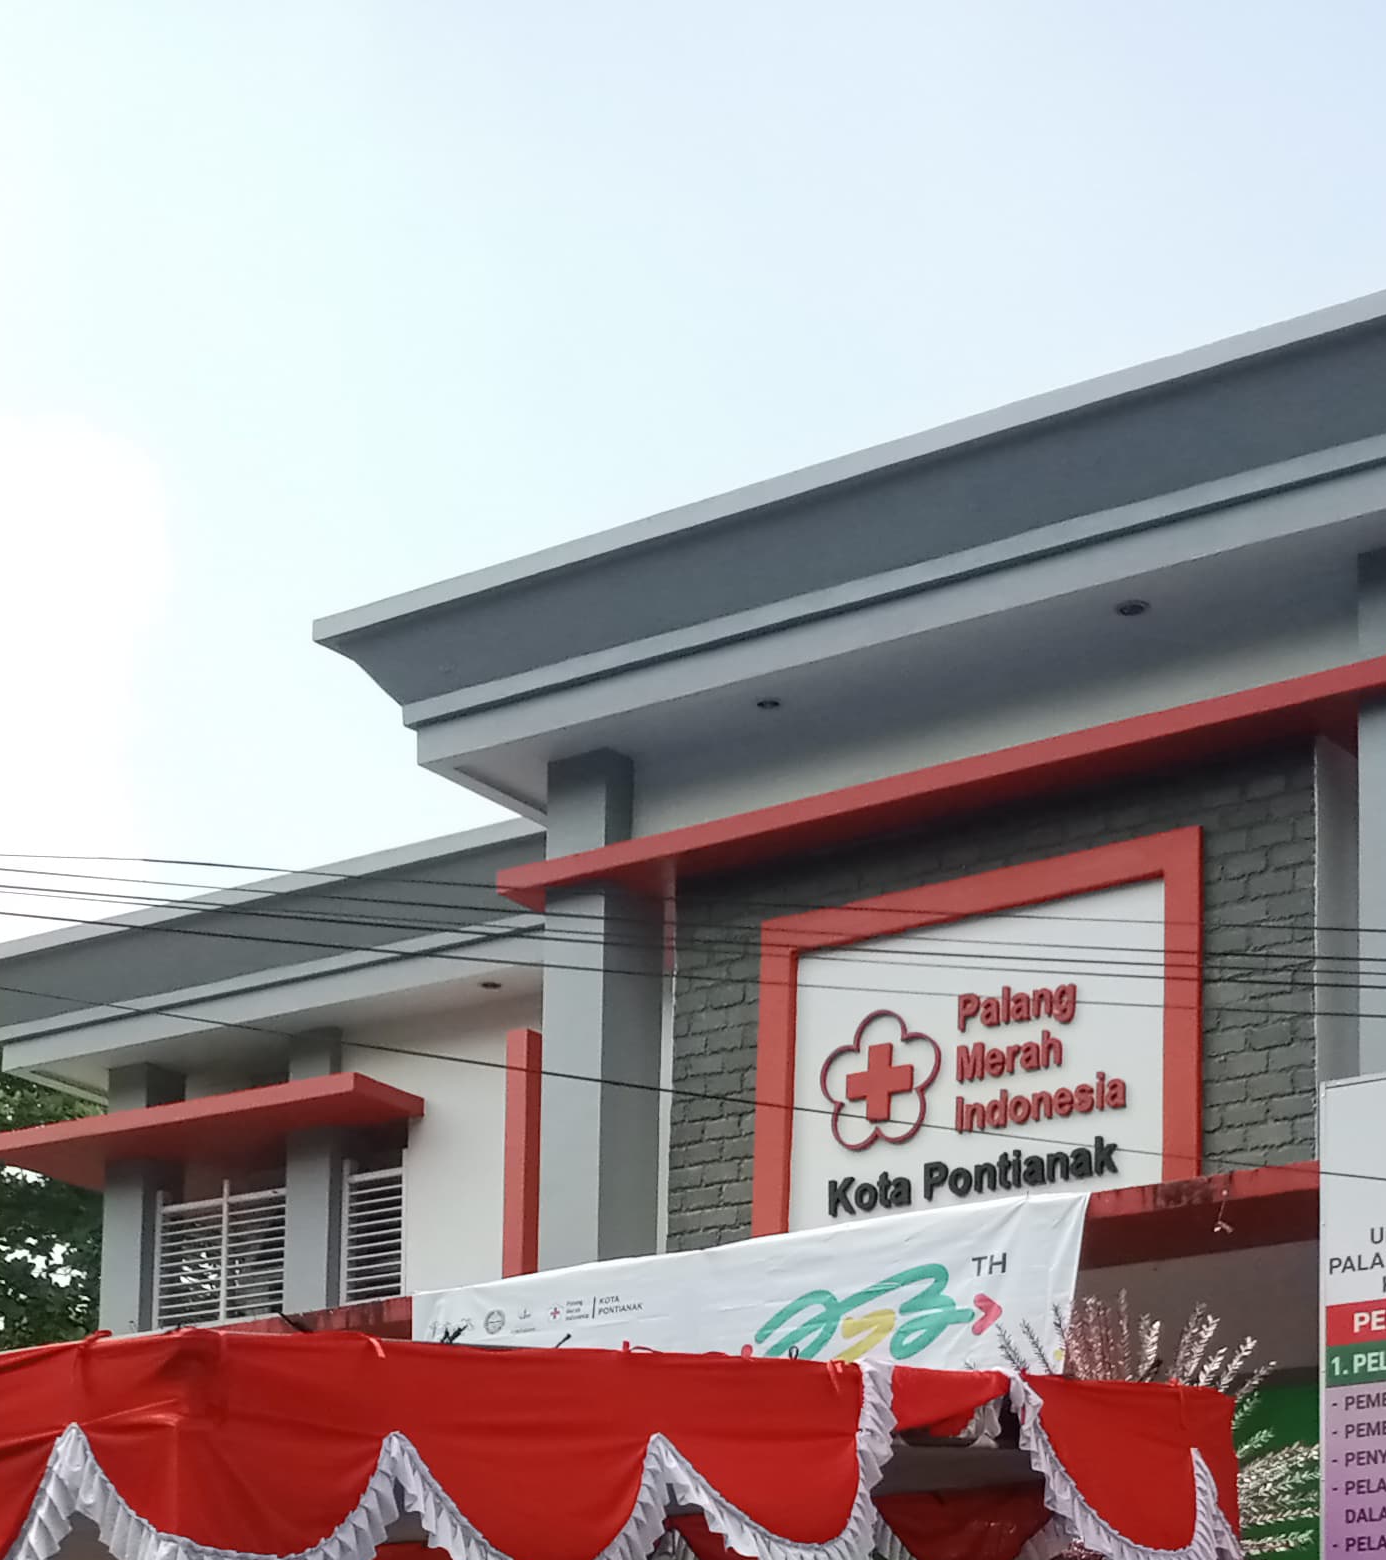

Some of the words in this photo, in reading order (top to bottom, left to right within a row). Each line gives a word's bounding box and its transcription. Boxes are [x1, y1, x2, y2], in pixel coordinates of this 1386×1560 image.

[957, 983, 1077, 1033] Palang
[956, 1030, 1063, 1084] Merah
[955, 1071, 1127, 1134] Indonesia
[828, 1171, 912, 1218] Kota
[923, 1136, 1118, 1202] Pontianak
[972, 1253, 1007, 1277] TH
[598, 1303, 644, 1316] PONTIANAK
[1331, 1356, 1349, 1377] 1.
